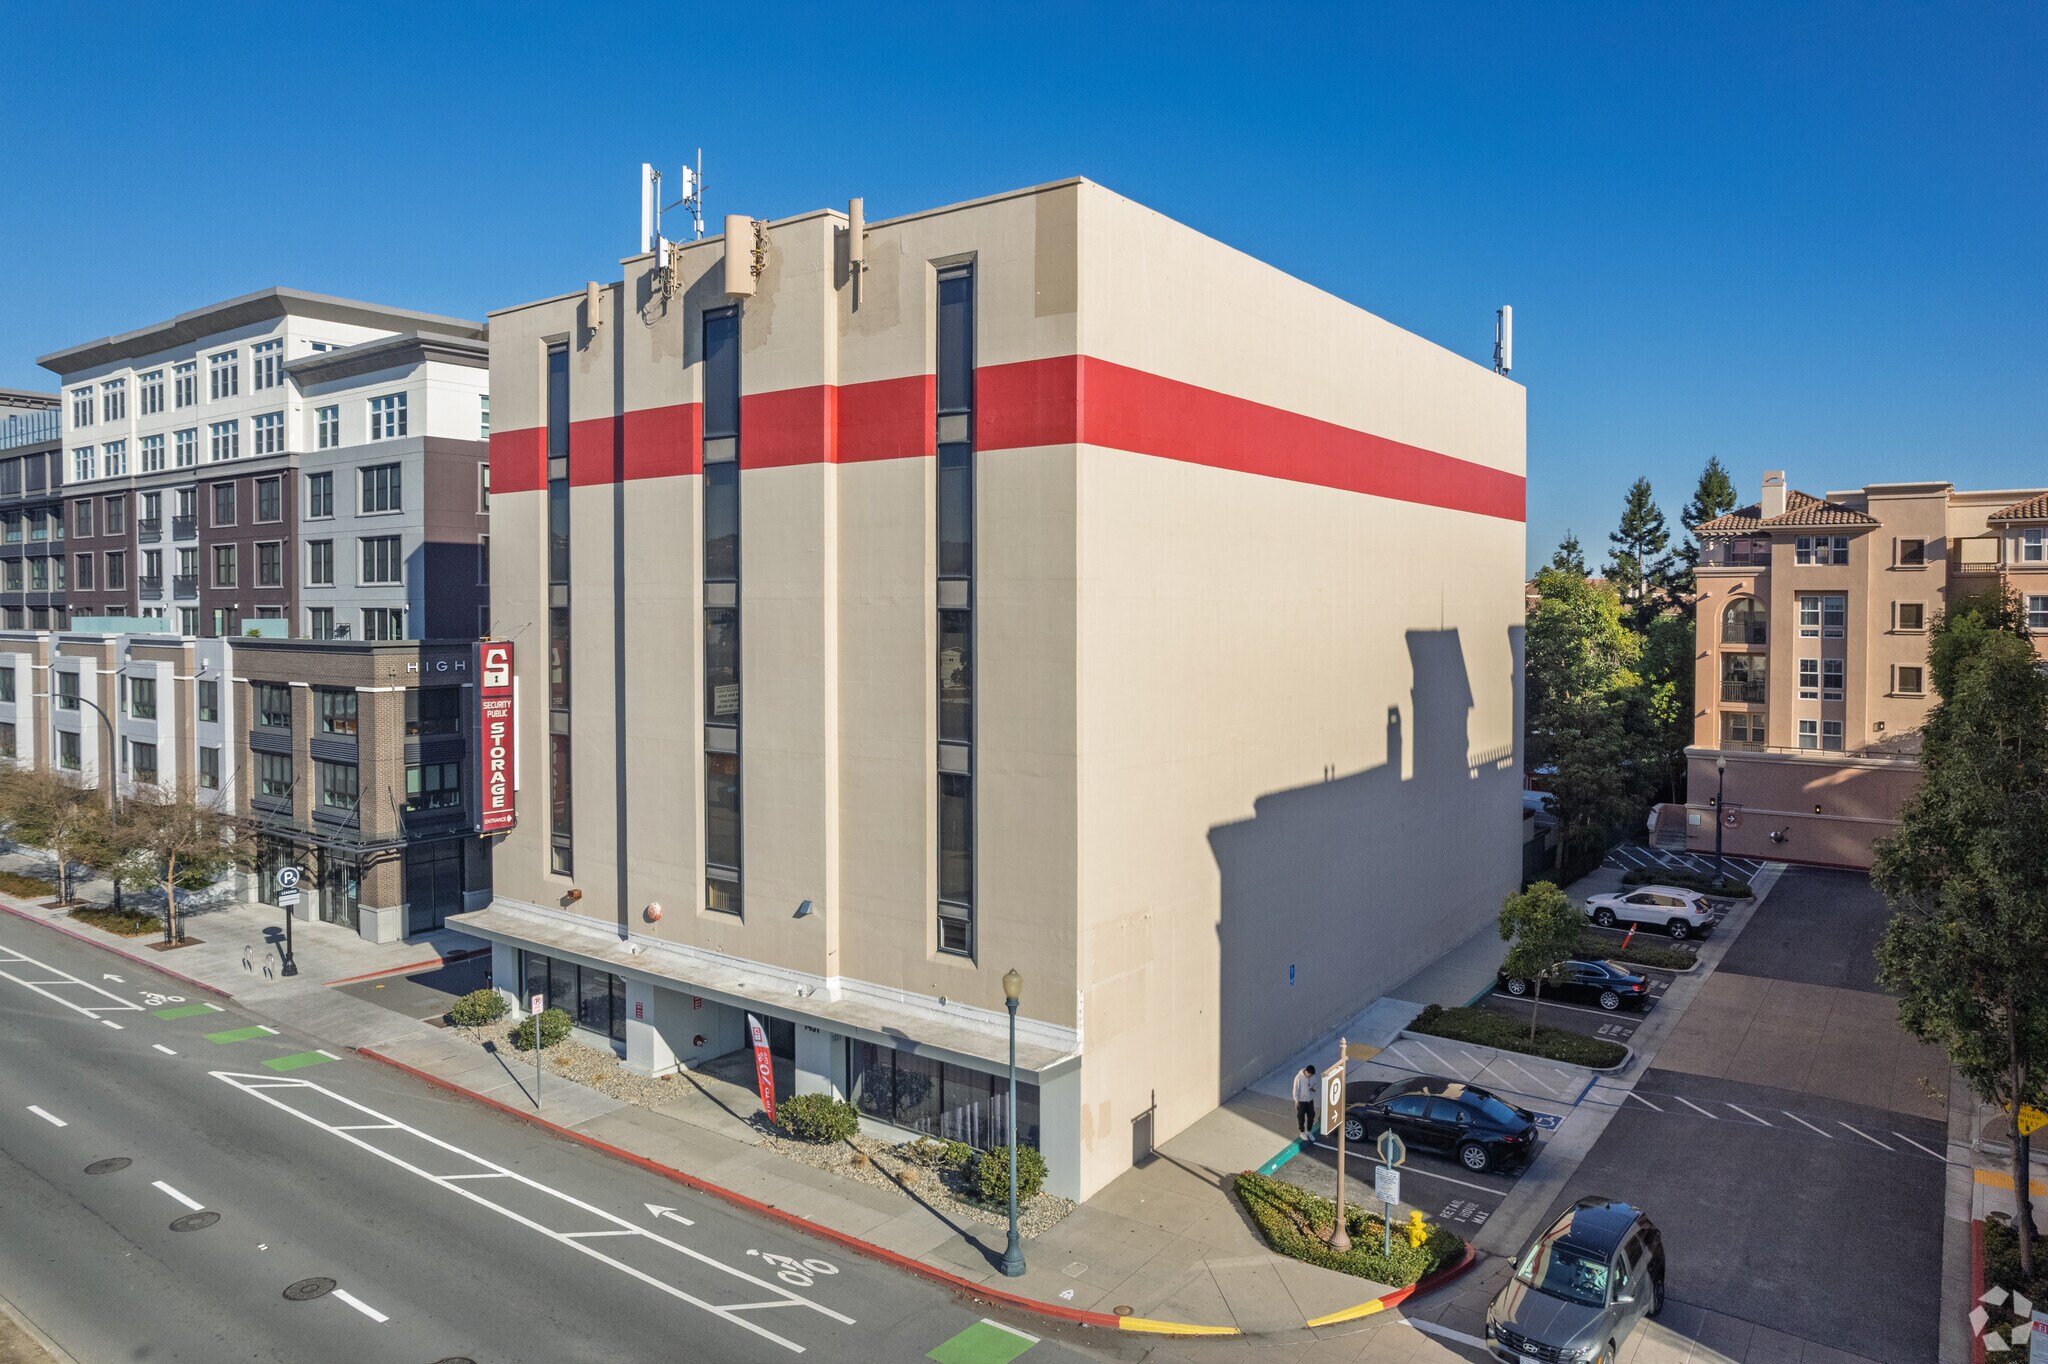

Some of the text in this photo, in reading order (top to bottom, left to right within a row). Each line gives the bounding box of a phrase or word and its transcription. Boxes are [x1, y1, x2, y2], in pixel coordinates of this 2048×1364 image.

[407, 661, 466, 673] HIGH
[483, 700, 511, 709] SECURITY
[487, 709, 507, 718] PUBLIC
[490, 722, 506, 808] STORAGE
[484, 816, 506, 824] ENTRANCE
[285, 872, 293, 884] P
[1332, 1083, 1339, 1102] P
[1439, 1200, 1465, 1219] RETAIL
[1458, 1203, 1480, 1218] HOUR
[1471, 1211, 1490, 1225] MAX
